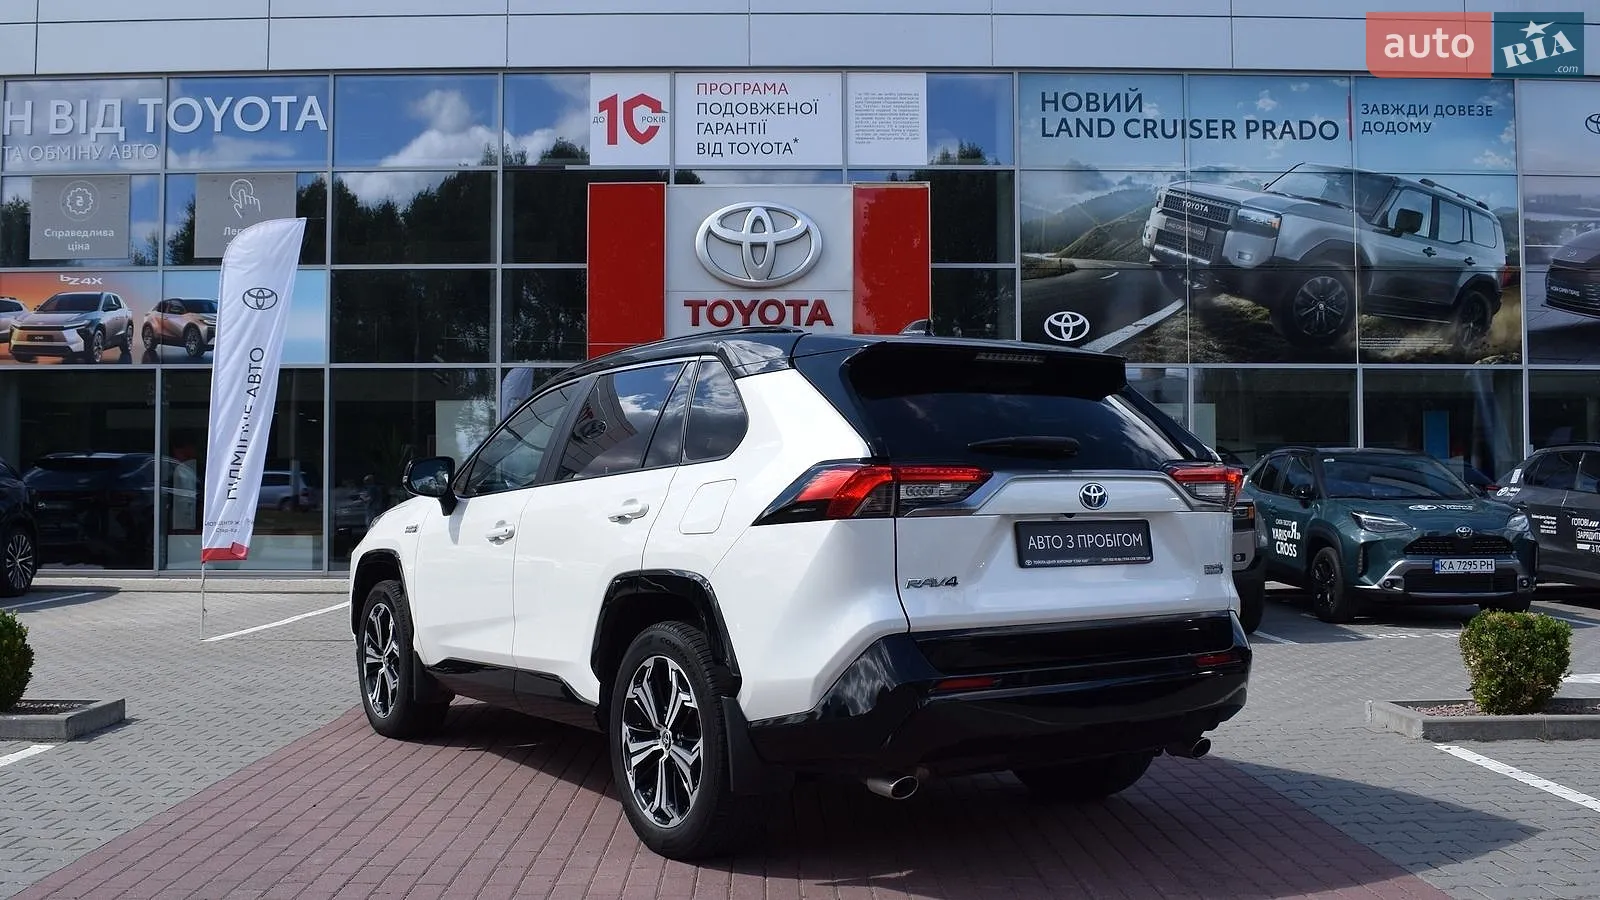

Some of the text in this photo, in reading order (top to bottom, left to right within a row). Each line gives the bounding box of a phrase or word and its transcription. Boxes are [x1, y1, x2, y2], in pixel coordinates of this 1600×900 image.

[696, 82, 789, 96] ПРОГРАМА
[1041, 87, 1143, 113] НОВИЙ
[696, 98, 819, 118] ПОДОВЖЕНОЇ
[1361, 103, 1493, 118] ЗАВЖДИ ДОВЕЗЕ
[50, 99, 126, 142] ВІД
[138, 95, 328, 134] TOYOTA
[593, 116, 605, 125] ДО
[696, 119, 768, 135] ГАРАНТІЇ
[1041, 118, 1340, 141] LAND CRUISER PRADO
[1361, 121, 1432, 135] ДОДОМУ
[28, 146, 104, 162] ОБМІНУ
[108, 144, 159, 160] АВТО
[696, 142, 724, 157] ВІД
[1182, 200, 1209, 213] TOYOTA
[44, 228, 115, 239] Справедлива
[67, 241, 90, 252] ціна
[684, 299, 834, 327] TOYOTA
[247, 347, 264, 397] АВТО
[1028, 532, 1143, 550] АВТО З ПРОБІГОМ
[1276, 541, 1297, 557] CROSS
[1440, 560, 1494, 571] KA 7295 PH
[905, 575, 959, 590] RAV4
